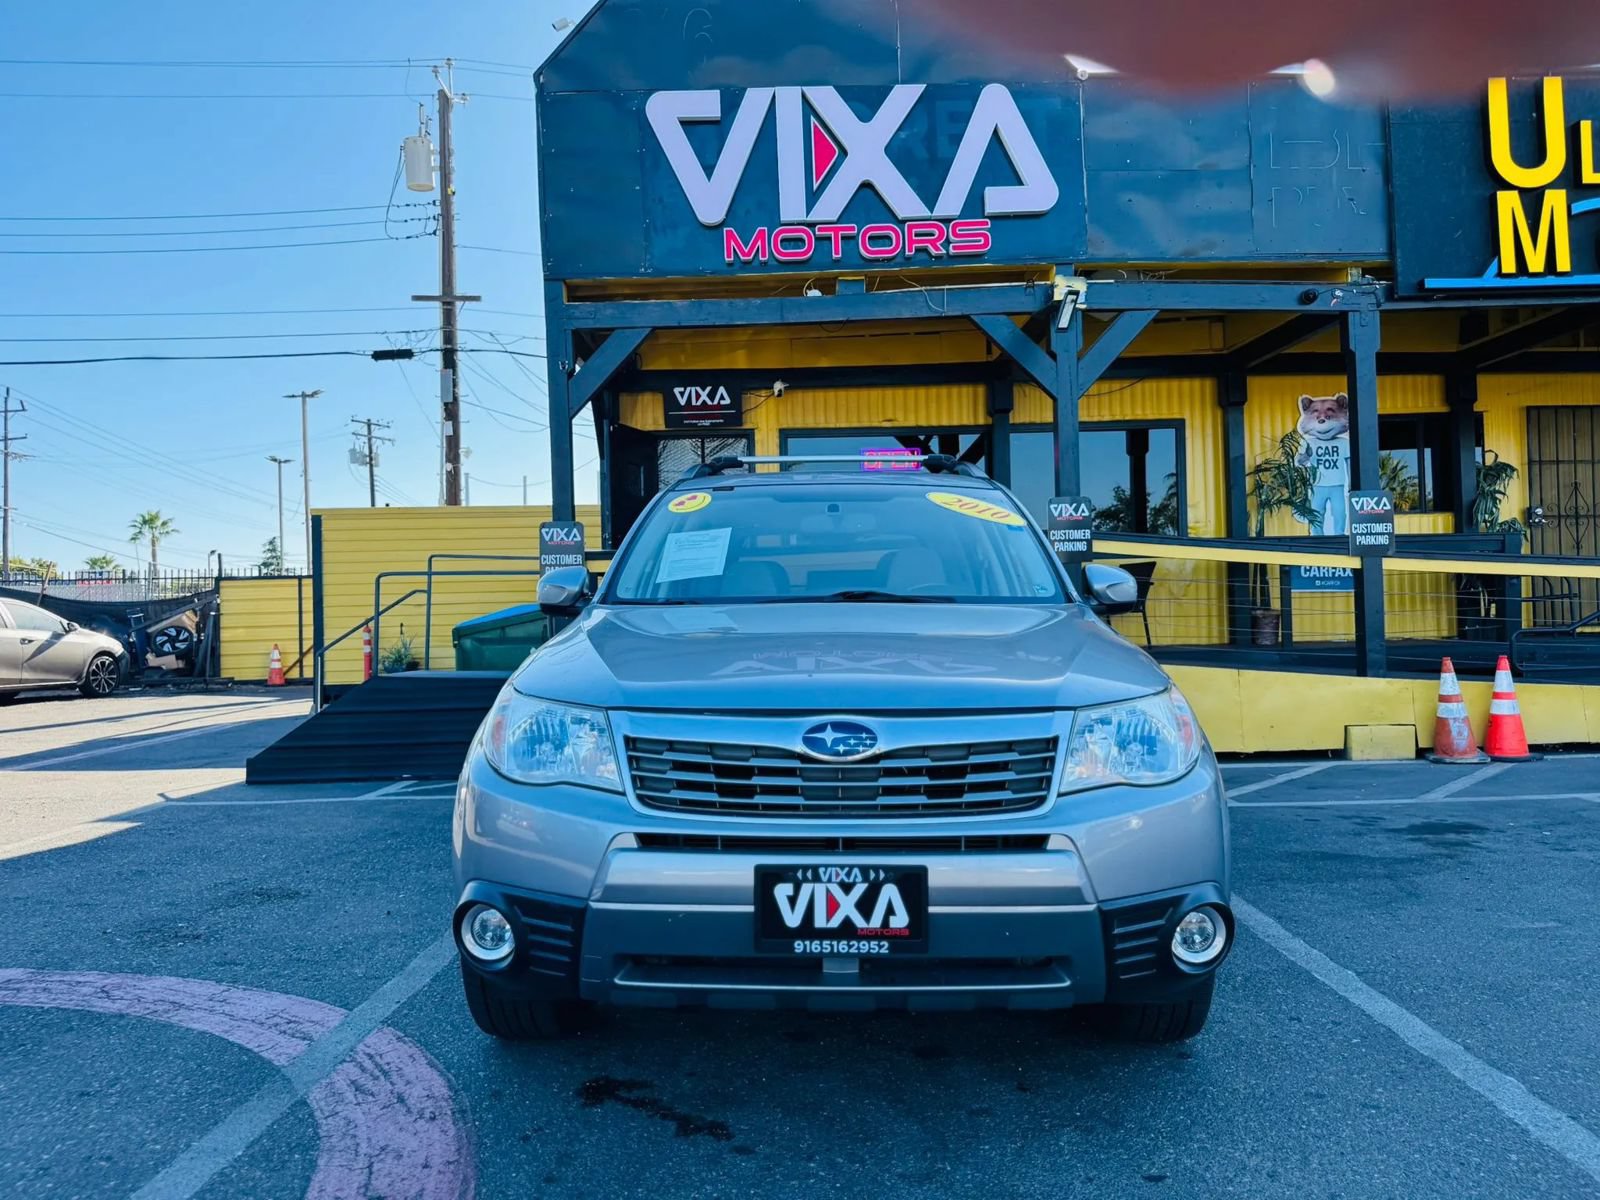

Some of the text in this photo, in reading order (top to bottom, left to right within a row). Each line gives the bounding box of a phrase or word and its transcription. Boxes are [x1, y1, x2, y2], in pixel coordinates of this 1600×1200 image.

[645, 83, 1060, 227] VIXA
[723, 219, 992, 263] MOTORS
[673, 386, 731, 406] VIXA
[1315, 445, 1340, 458] CAR
[1315, 458, 1340, 470] FOX
[941, 498, 1010, 519] 2010
[1351, 496, 1391, 510] VIXA
[1050, 503, 1089, 517] VIXA
[541, 527, 582, 541] VIXA
[1050, 529, 1091, 540] CUSTOMER
[1352, 523, 1393, 533] CUSTOMER
[1054, 541, 1087, 551] PARKING
[1356, 535, 1389, 545] PARKING
[541, 554, 583, 565] CUSTOMER
[1300, 565, 1354, 577] CARFAX
[818, 867, 862, 882] VIXA
[773, 883, 910, 928] VIXA
[857, 928, 910, 936] MOTORS
[793, 940, 890, 953] 9165162952
